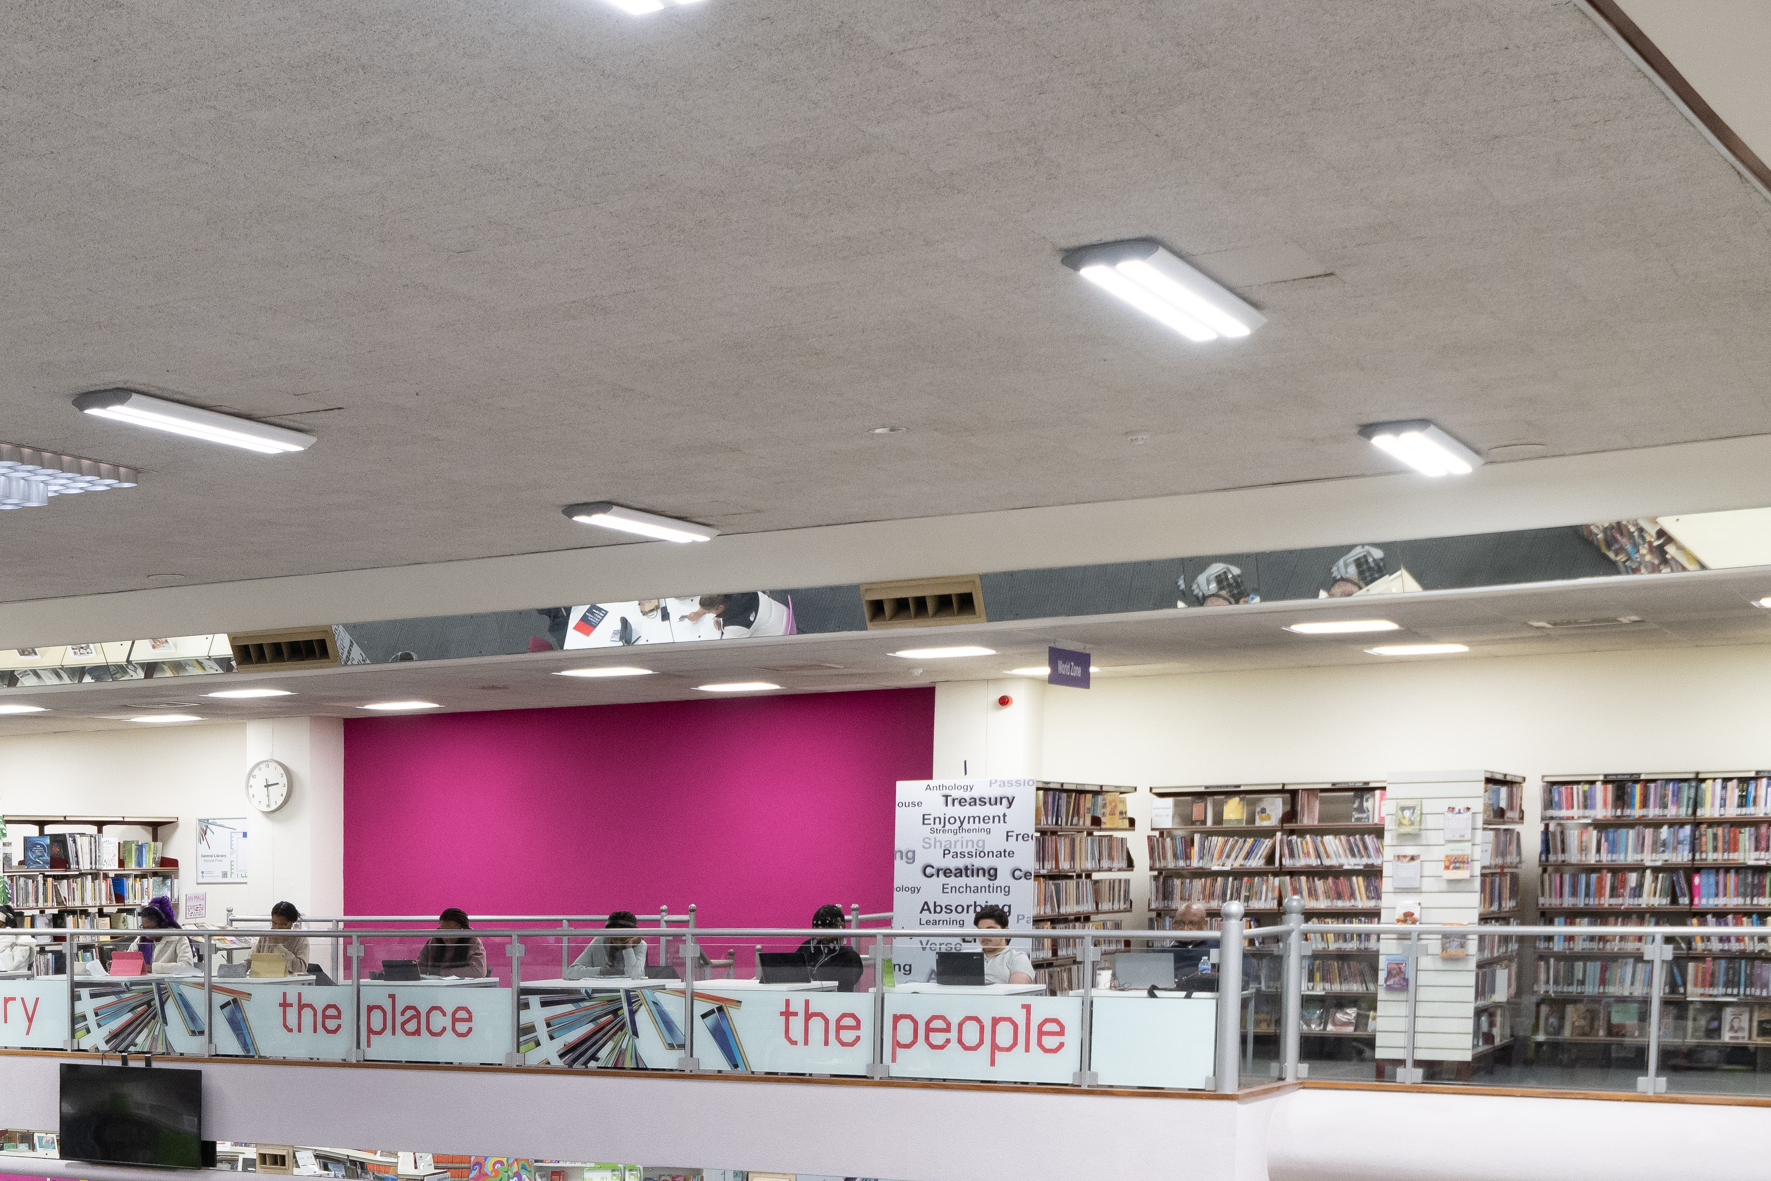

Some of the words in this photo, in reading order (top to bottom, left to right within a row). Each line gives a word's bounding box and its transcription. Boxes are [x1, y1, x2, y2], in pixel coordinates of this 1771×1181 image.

[1057, 659, 1070, 674] World
[1070, 664, 1082, 677] Zone
[925, 784, 974, 792] Anthology
[942, 795, 1015, 809] Treasury
[922, 812, 1007, 828] Enjoyment
[930, 827, 991, 835] Strengthening
[922, 836, 986, 851] Sharing
[943, 849, 1015, 859] Passionate
[922, 865, 998, 881] Creating
[942, 884, 1011, 896] Enchanting
[919, 918, 965, 927] Learning
[920, 940, 962, 951] Verse
[279, 992, 342, 1035] the
[366, 1000, 474, 1040] place
[779, 998, 861, 1048] the
[892, 1004, 1066, 1067] people
